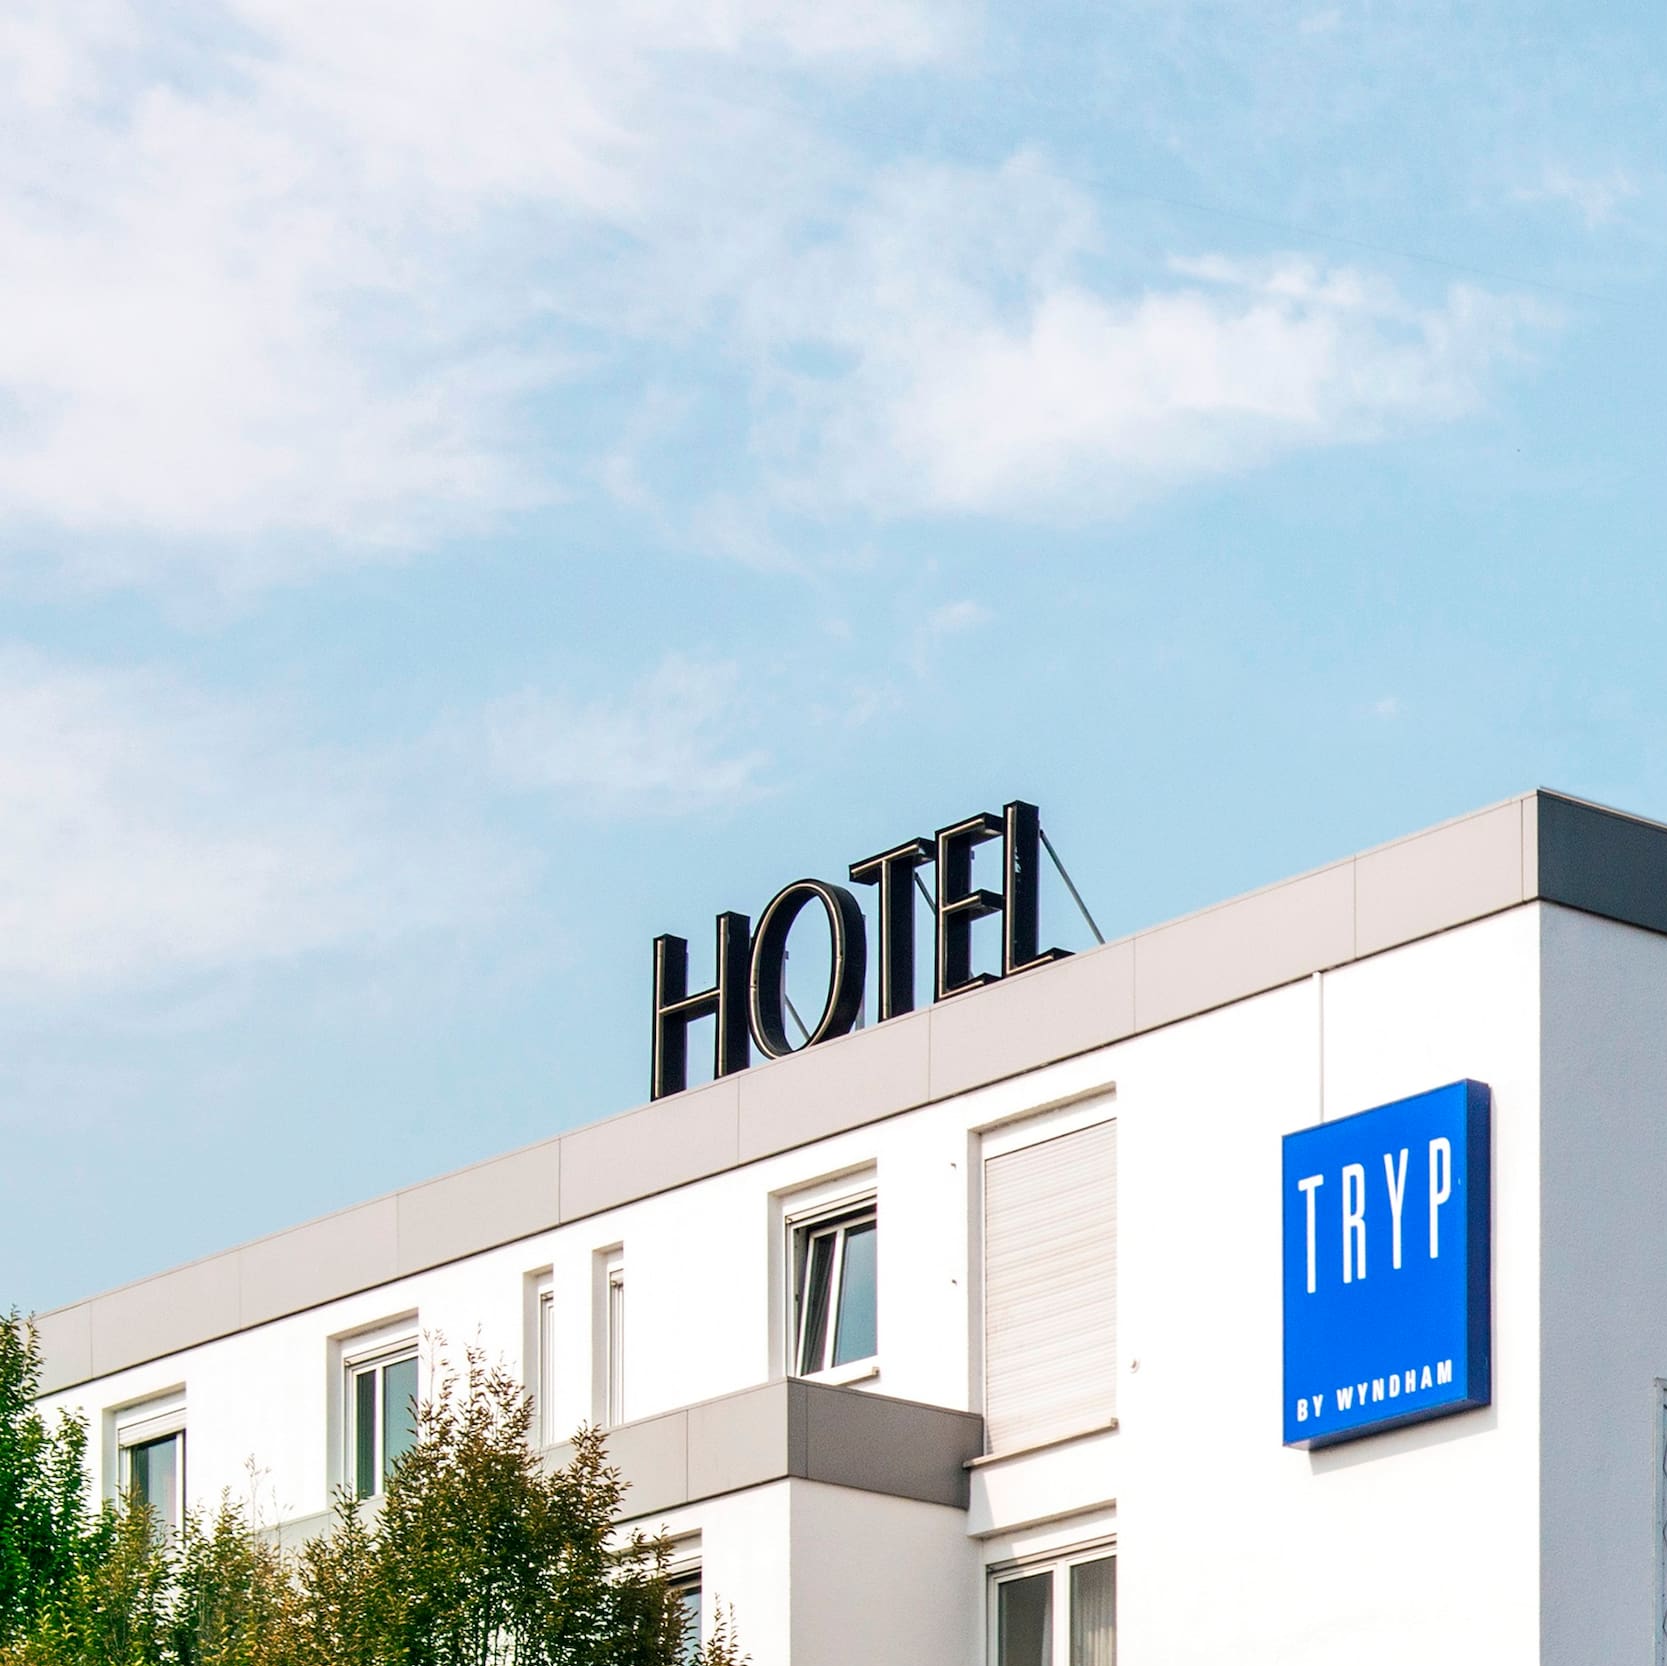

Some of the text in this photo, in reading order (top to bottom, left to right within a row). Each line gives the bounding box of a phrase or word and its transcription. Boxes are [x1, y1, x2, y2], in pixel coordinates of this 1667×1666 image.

[651, 800, 1076, 1101] HOTEL
[1298, 1137, 1451, 1294] TRYP
[1297, 1359, 1453, 1422] BY WYNDHAM
